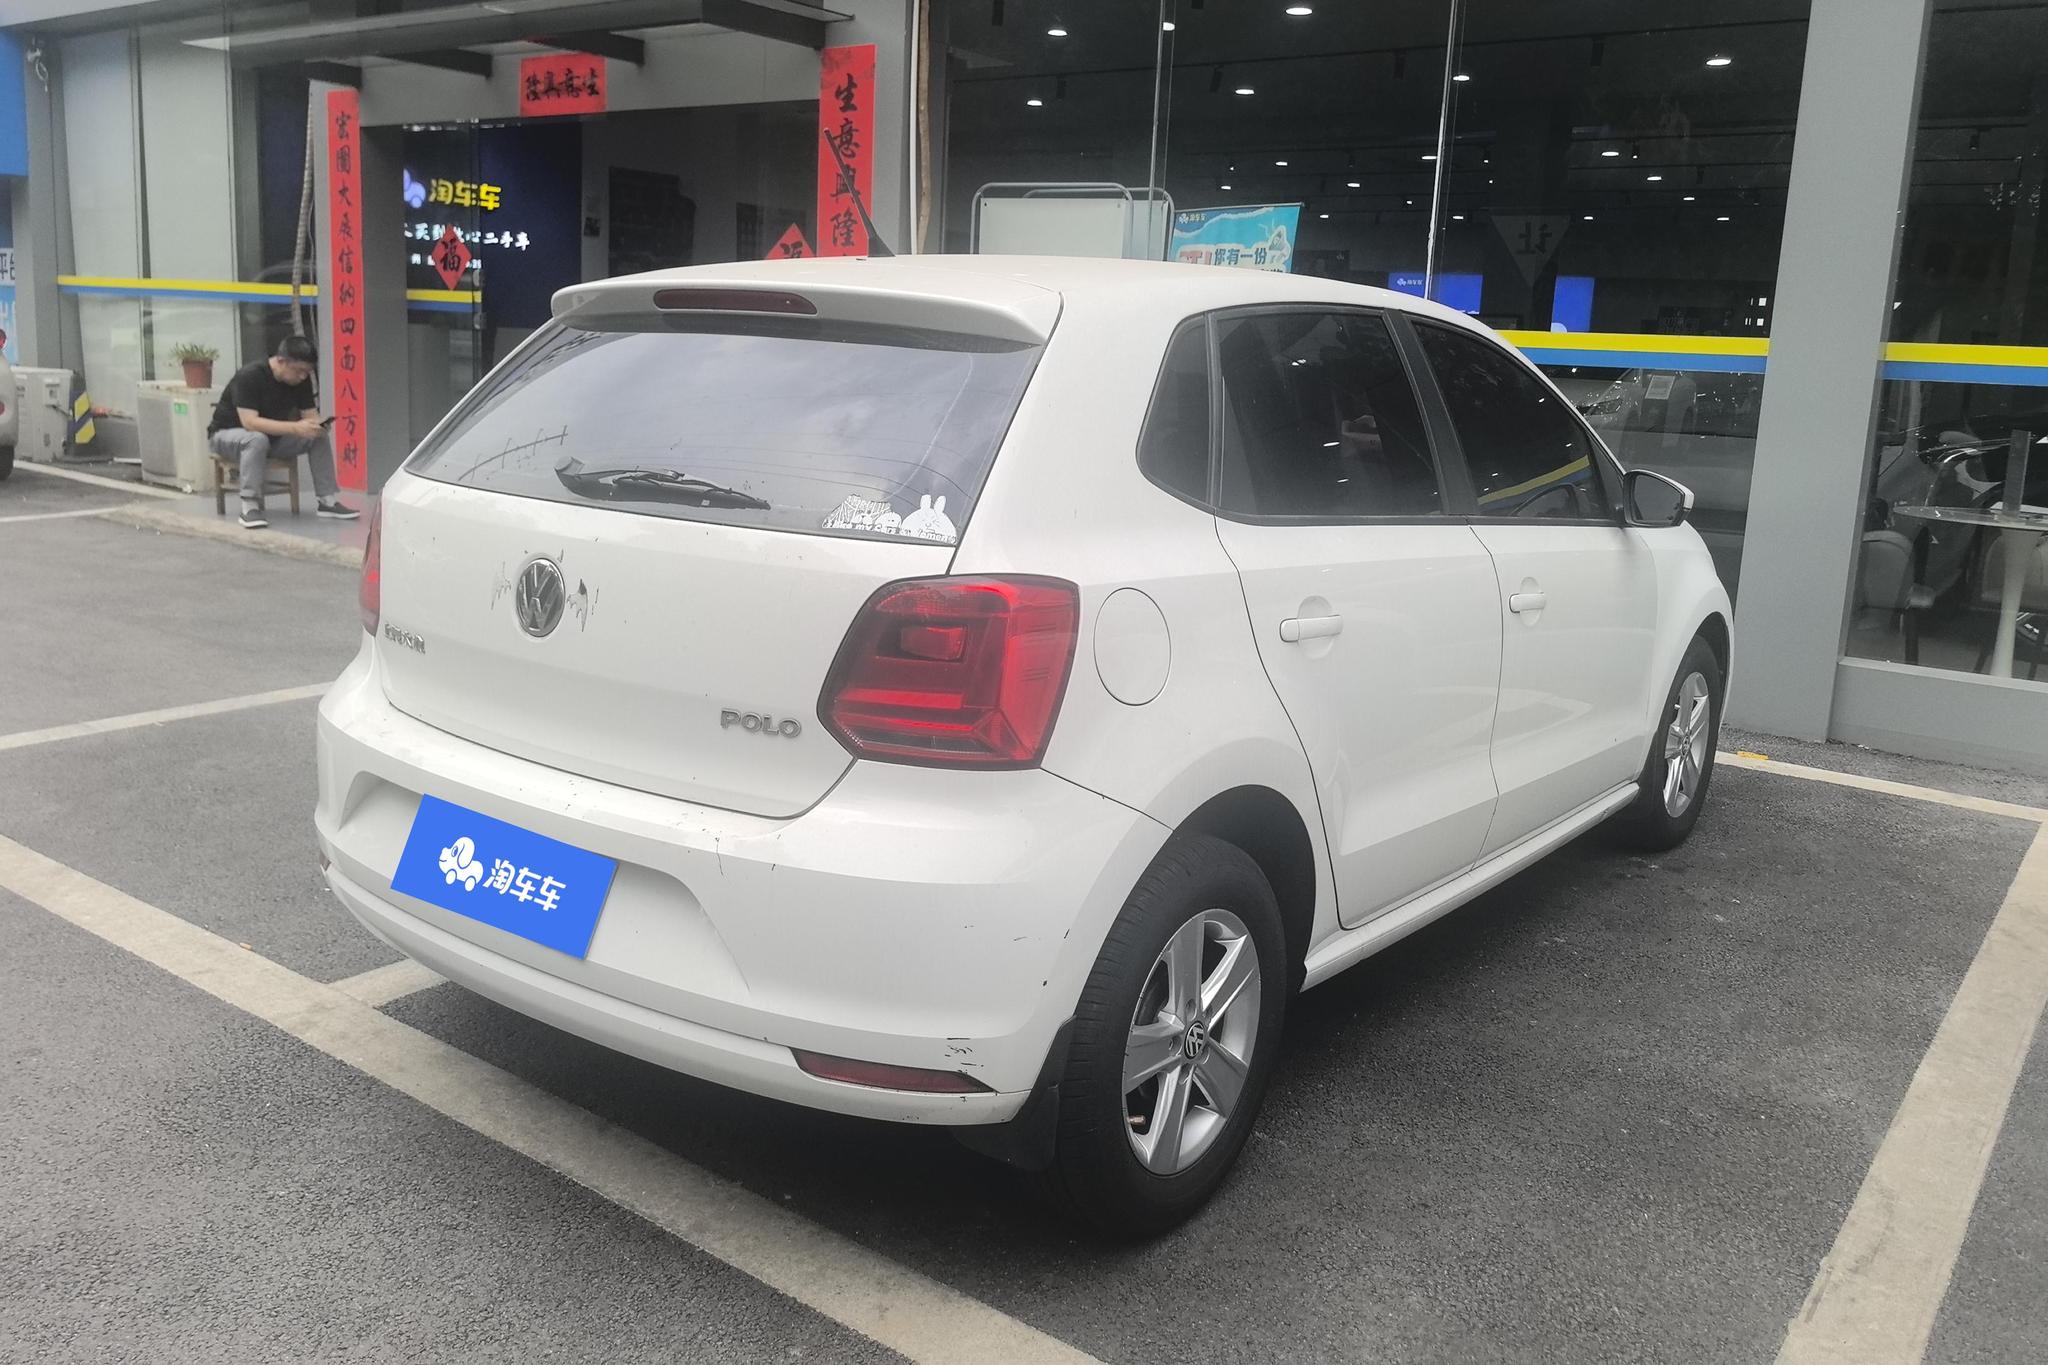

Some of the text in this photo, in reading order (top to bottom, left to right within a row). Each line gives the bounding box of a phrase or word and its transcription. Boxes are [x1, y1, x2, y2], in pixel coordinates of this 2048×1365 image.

[429, 178, 502, 211] 淘车车
[720, 708, 802, 738] POLO
